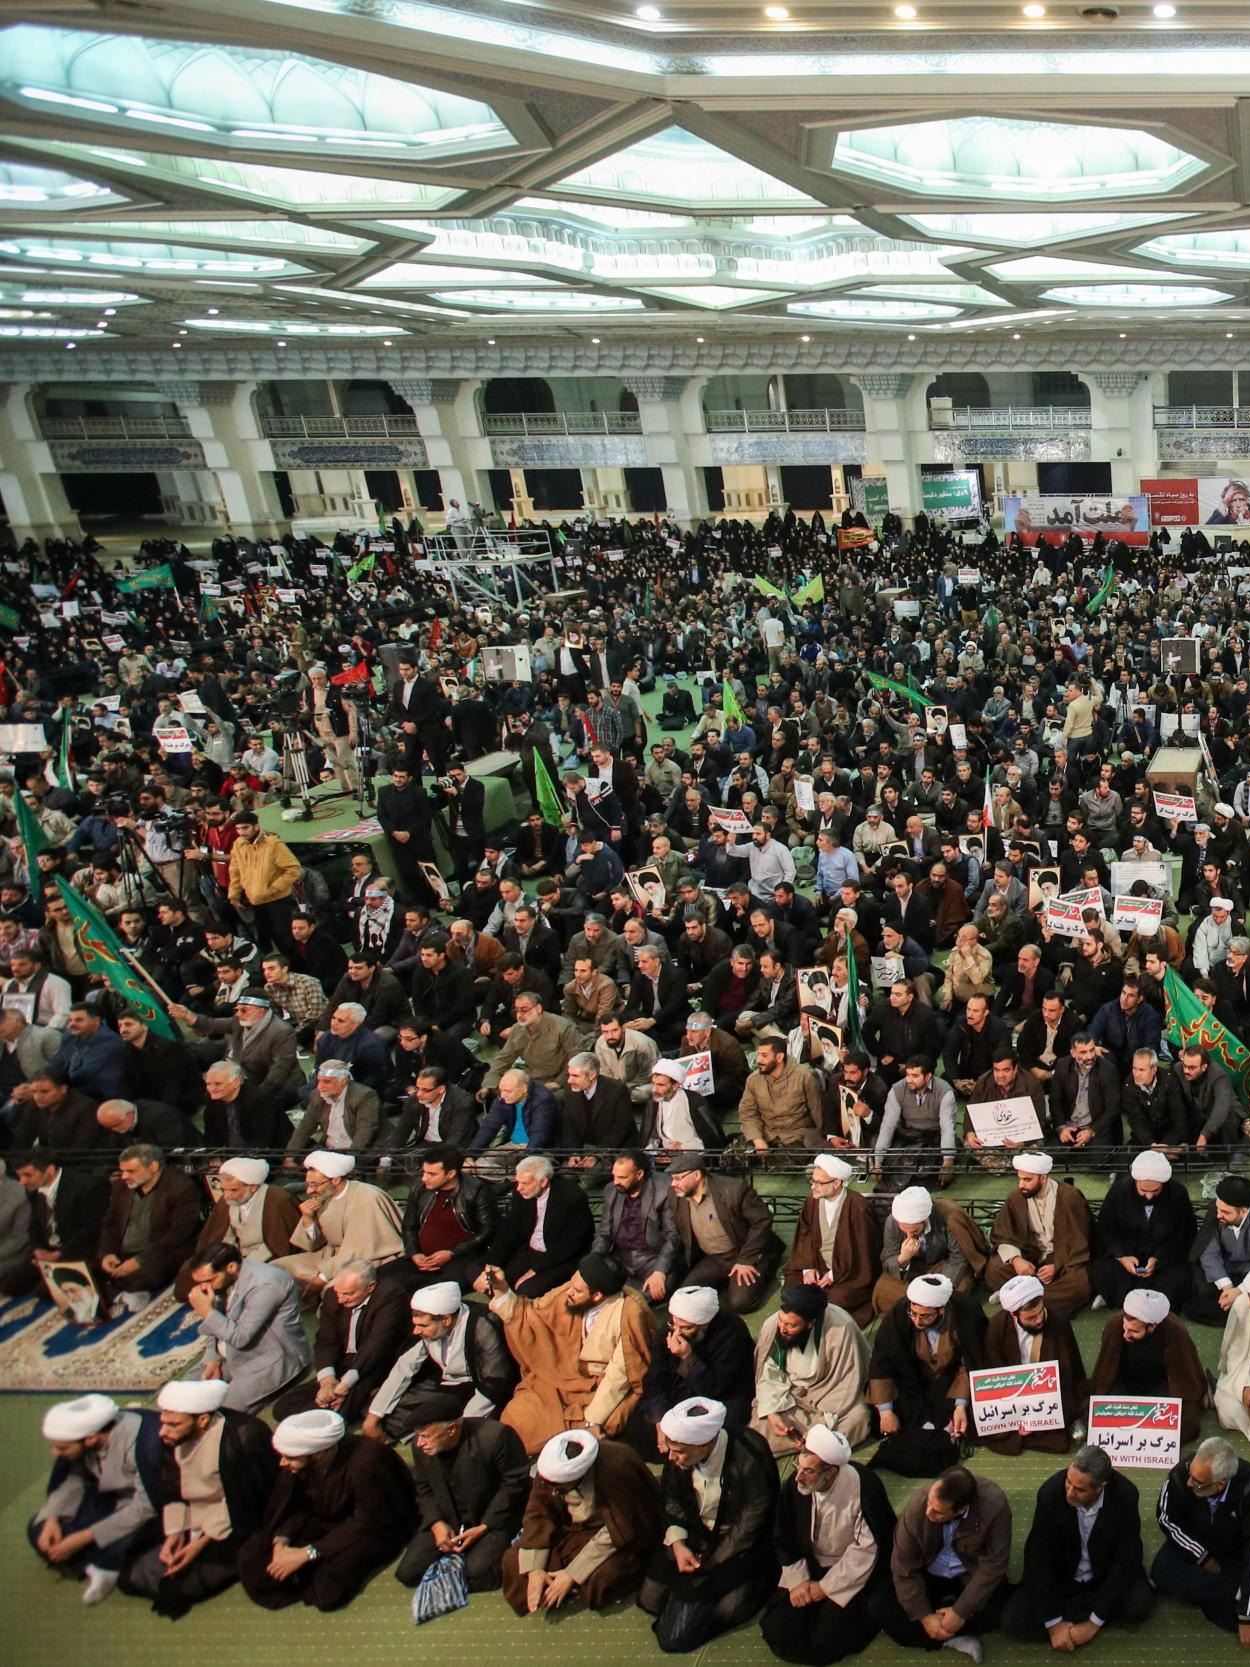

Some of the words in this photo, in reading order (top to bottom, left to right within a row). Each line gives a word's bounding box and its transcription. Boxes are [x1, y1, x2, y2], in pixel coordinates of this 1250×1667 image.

[1046, 499, 1083, 525] آمد
[1082, 501, 1128, 525] ملت
[1072, 925, 1085, 934] مرگ
[875, 964, 893, 980] بصیرت
[889, 967, 903, 980] روز
[693, 1077, 710, 1086] مرگ
[978, 1403, 1017, 1422] اسرائیل
[1021, 1405, 1030, 1415] بر
[1033, 1400, 1058, 1415] مرگ
[981, 1423, 1007, 1432] DOWN
[1030, 1418, 1060, 1428] ISRAEL
[1092, 1432, 1133, 1450] اسرائیل
[1136, 1439, 1147, 1451] بر
[1150, 1436, 1176, 1452] مرگ
[1120, 1455, 1141, 1463] WITH
[1144, 1456, 1175, 1465] ISRAEL
